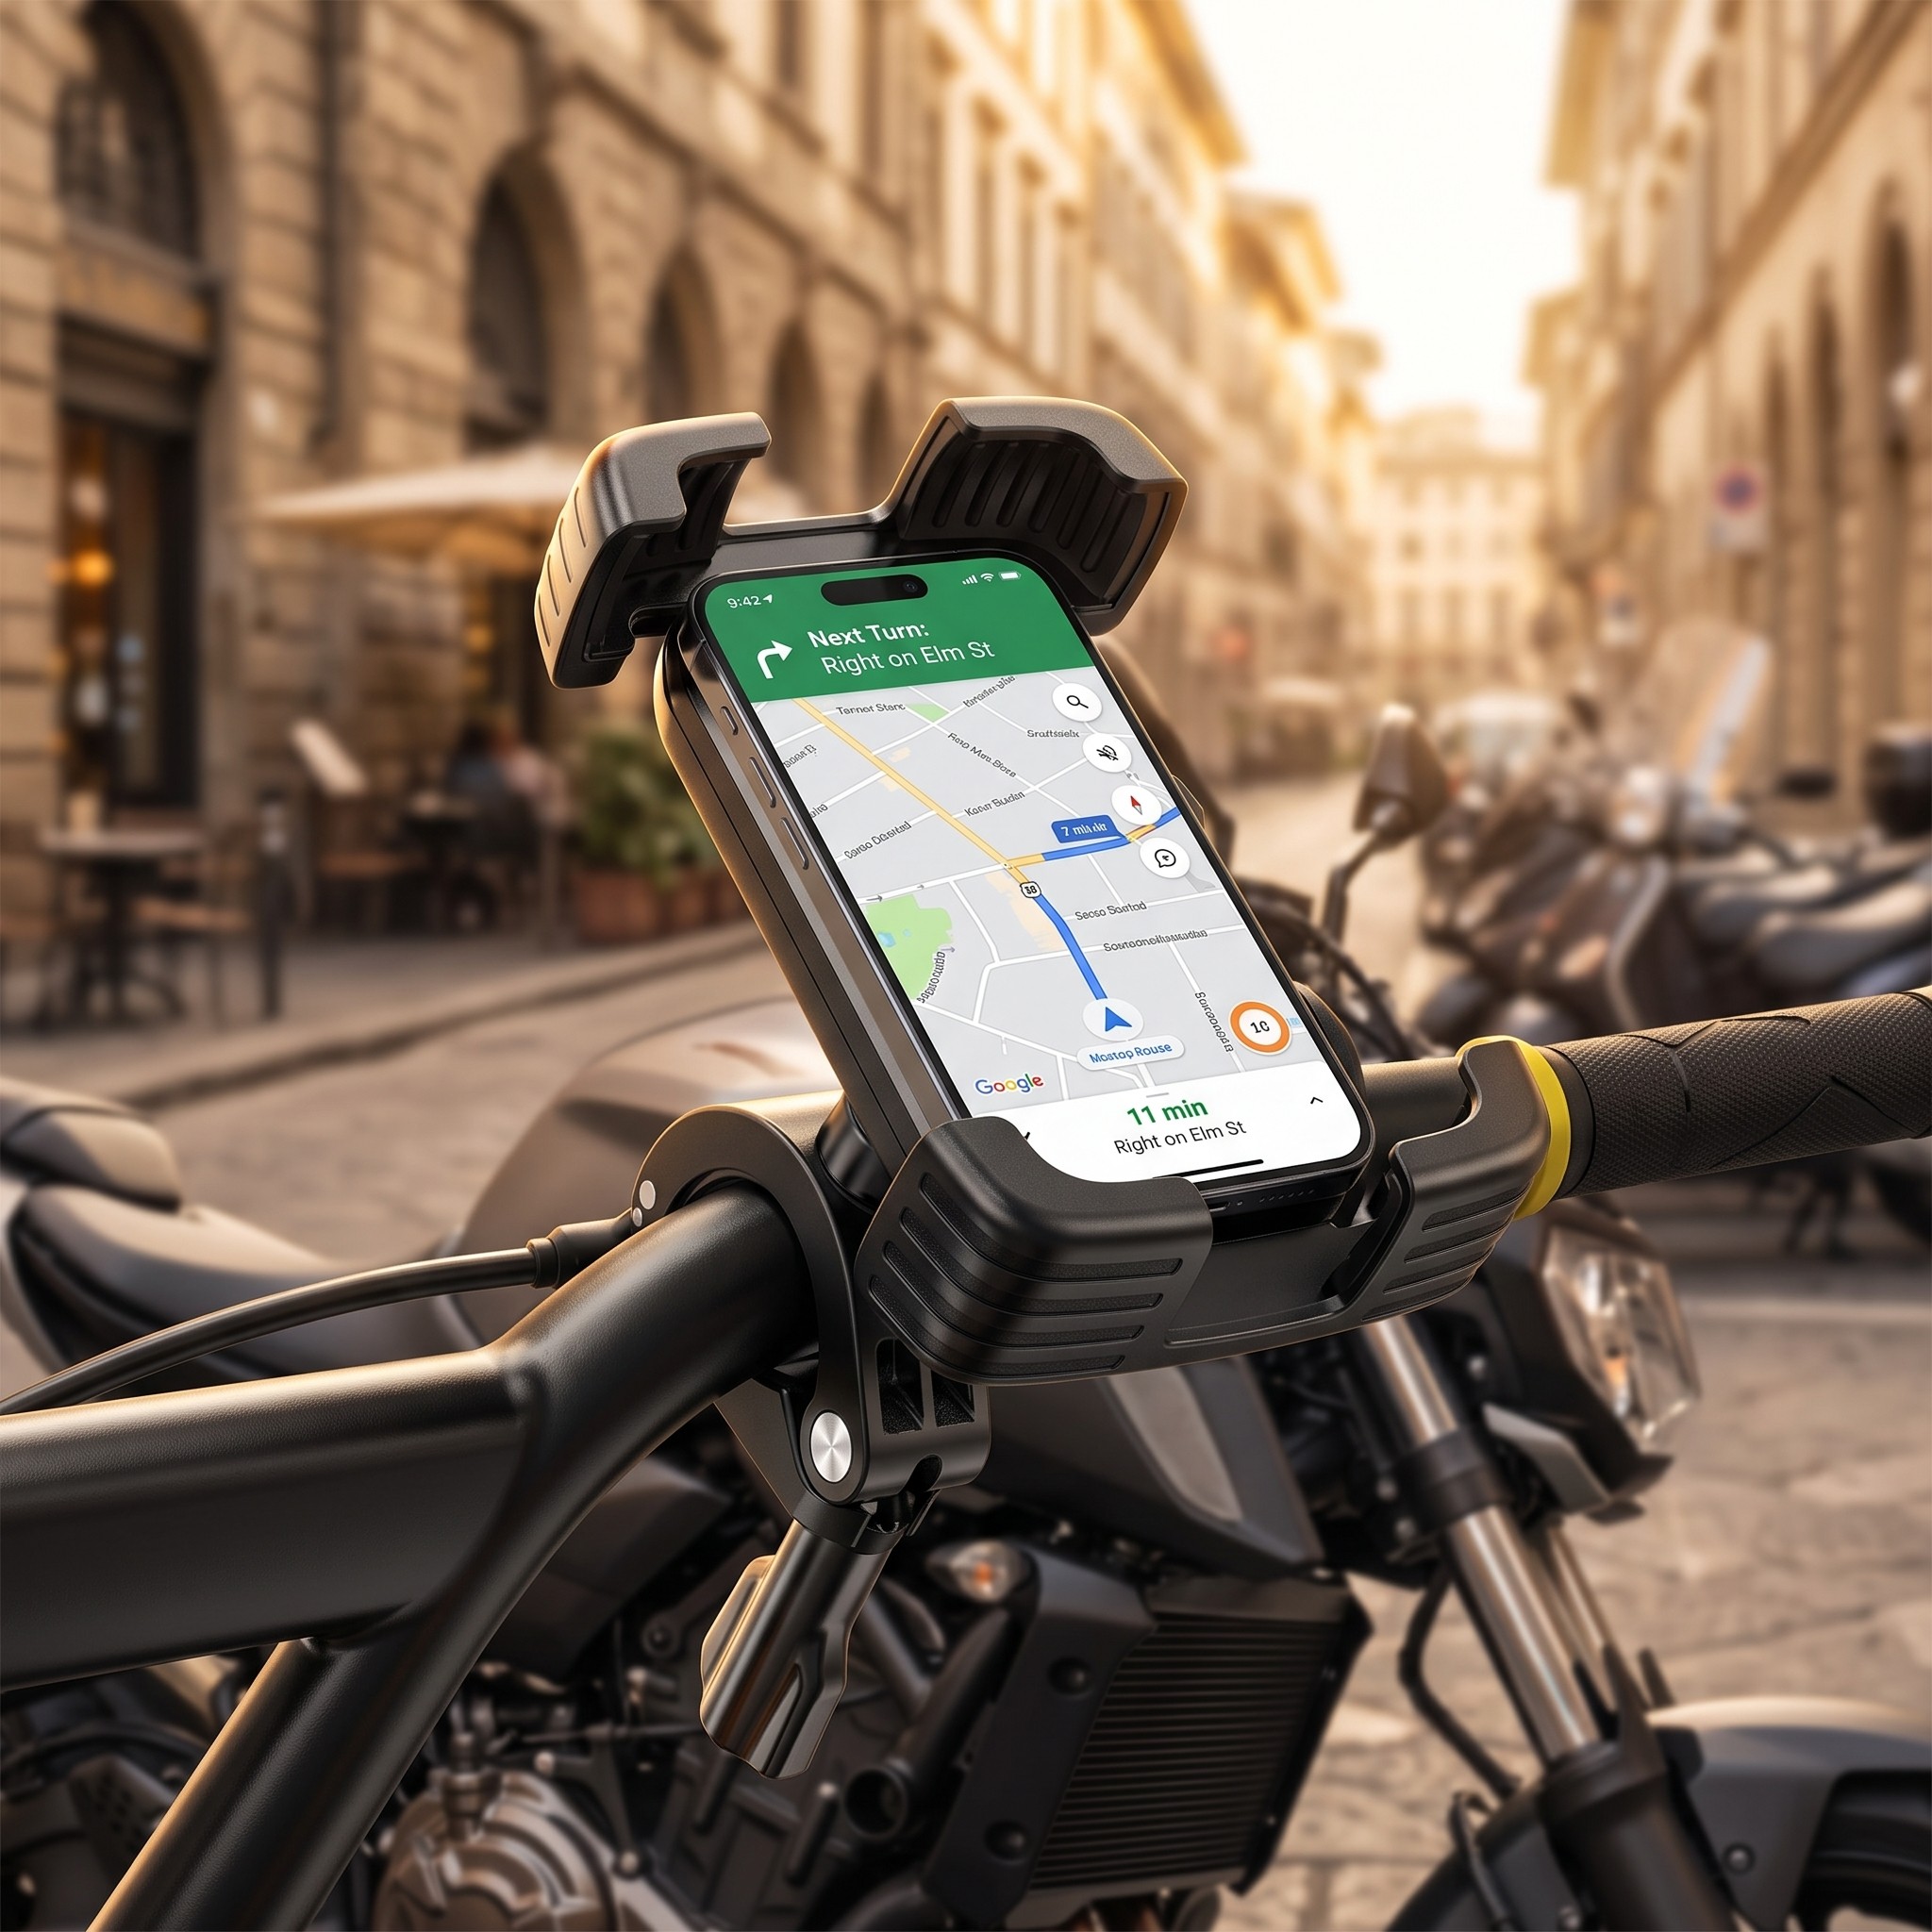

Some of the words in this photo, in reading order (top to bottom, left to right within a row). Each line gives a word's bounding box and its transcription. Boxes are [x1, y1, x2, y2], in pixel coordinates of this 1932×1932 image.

[726, 595, 761, 609] 9:42
[807, 627, 866, 648] Next
[867, 622, 929, 642] Turn:
[821, 650, 885, 676] Right
[888, 652, 917, 668] on
[920, 644, 965, 664] Elm
[967, 641, 996, 658] St
[1134, 1042, 1173, 1057] Rouse
[975, 1074, 1044, 1094] Google
[1126, 1105, 1157, 1125] 11
[1161, 1099, 1208, 1123] min
[1113, 1135, 1162, 1156] Right
[1164, 1131, 1188, 1146] on
[1190, 1124, 1224, 1142] Elm
[1225, 1120, 1247, 1137] St
